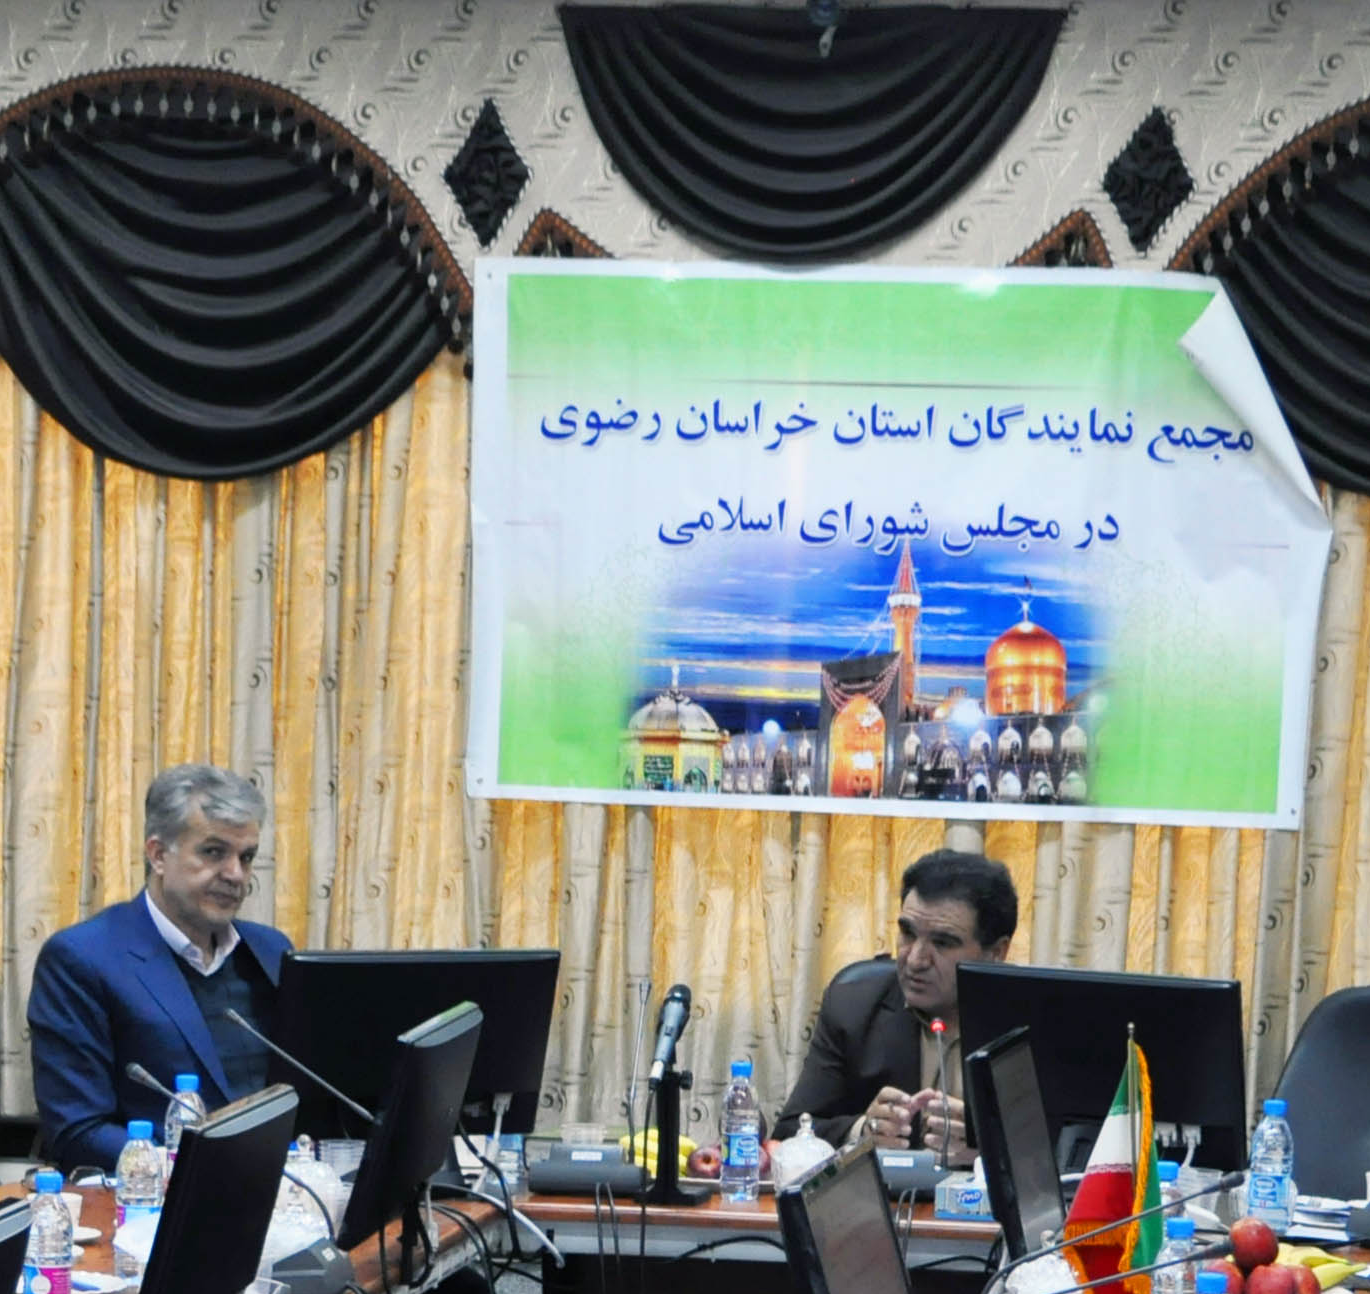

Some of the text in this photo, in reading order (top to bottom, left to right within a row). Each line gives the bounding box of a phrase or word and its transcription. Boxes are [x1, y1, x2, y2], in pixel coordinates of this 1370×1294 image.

[540, 398, 662, 447] رضوی
[674, 399, 819, 451] خراسان
[833, 403, 935, 446] استان
[1145, 423, 1255, 464] مجمع
[657, 496, 1121, 554] در مجلس شورای اسلامی
